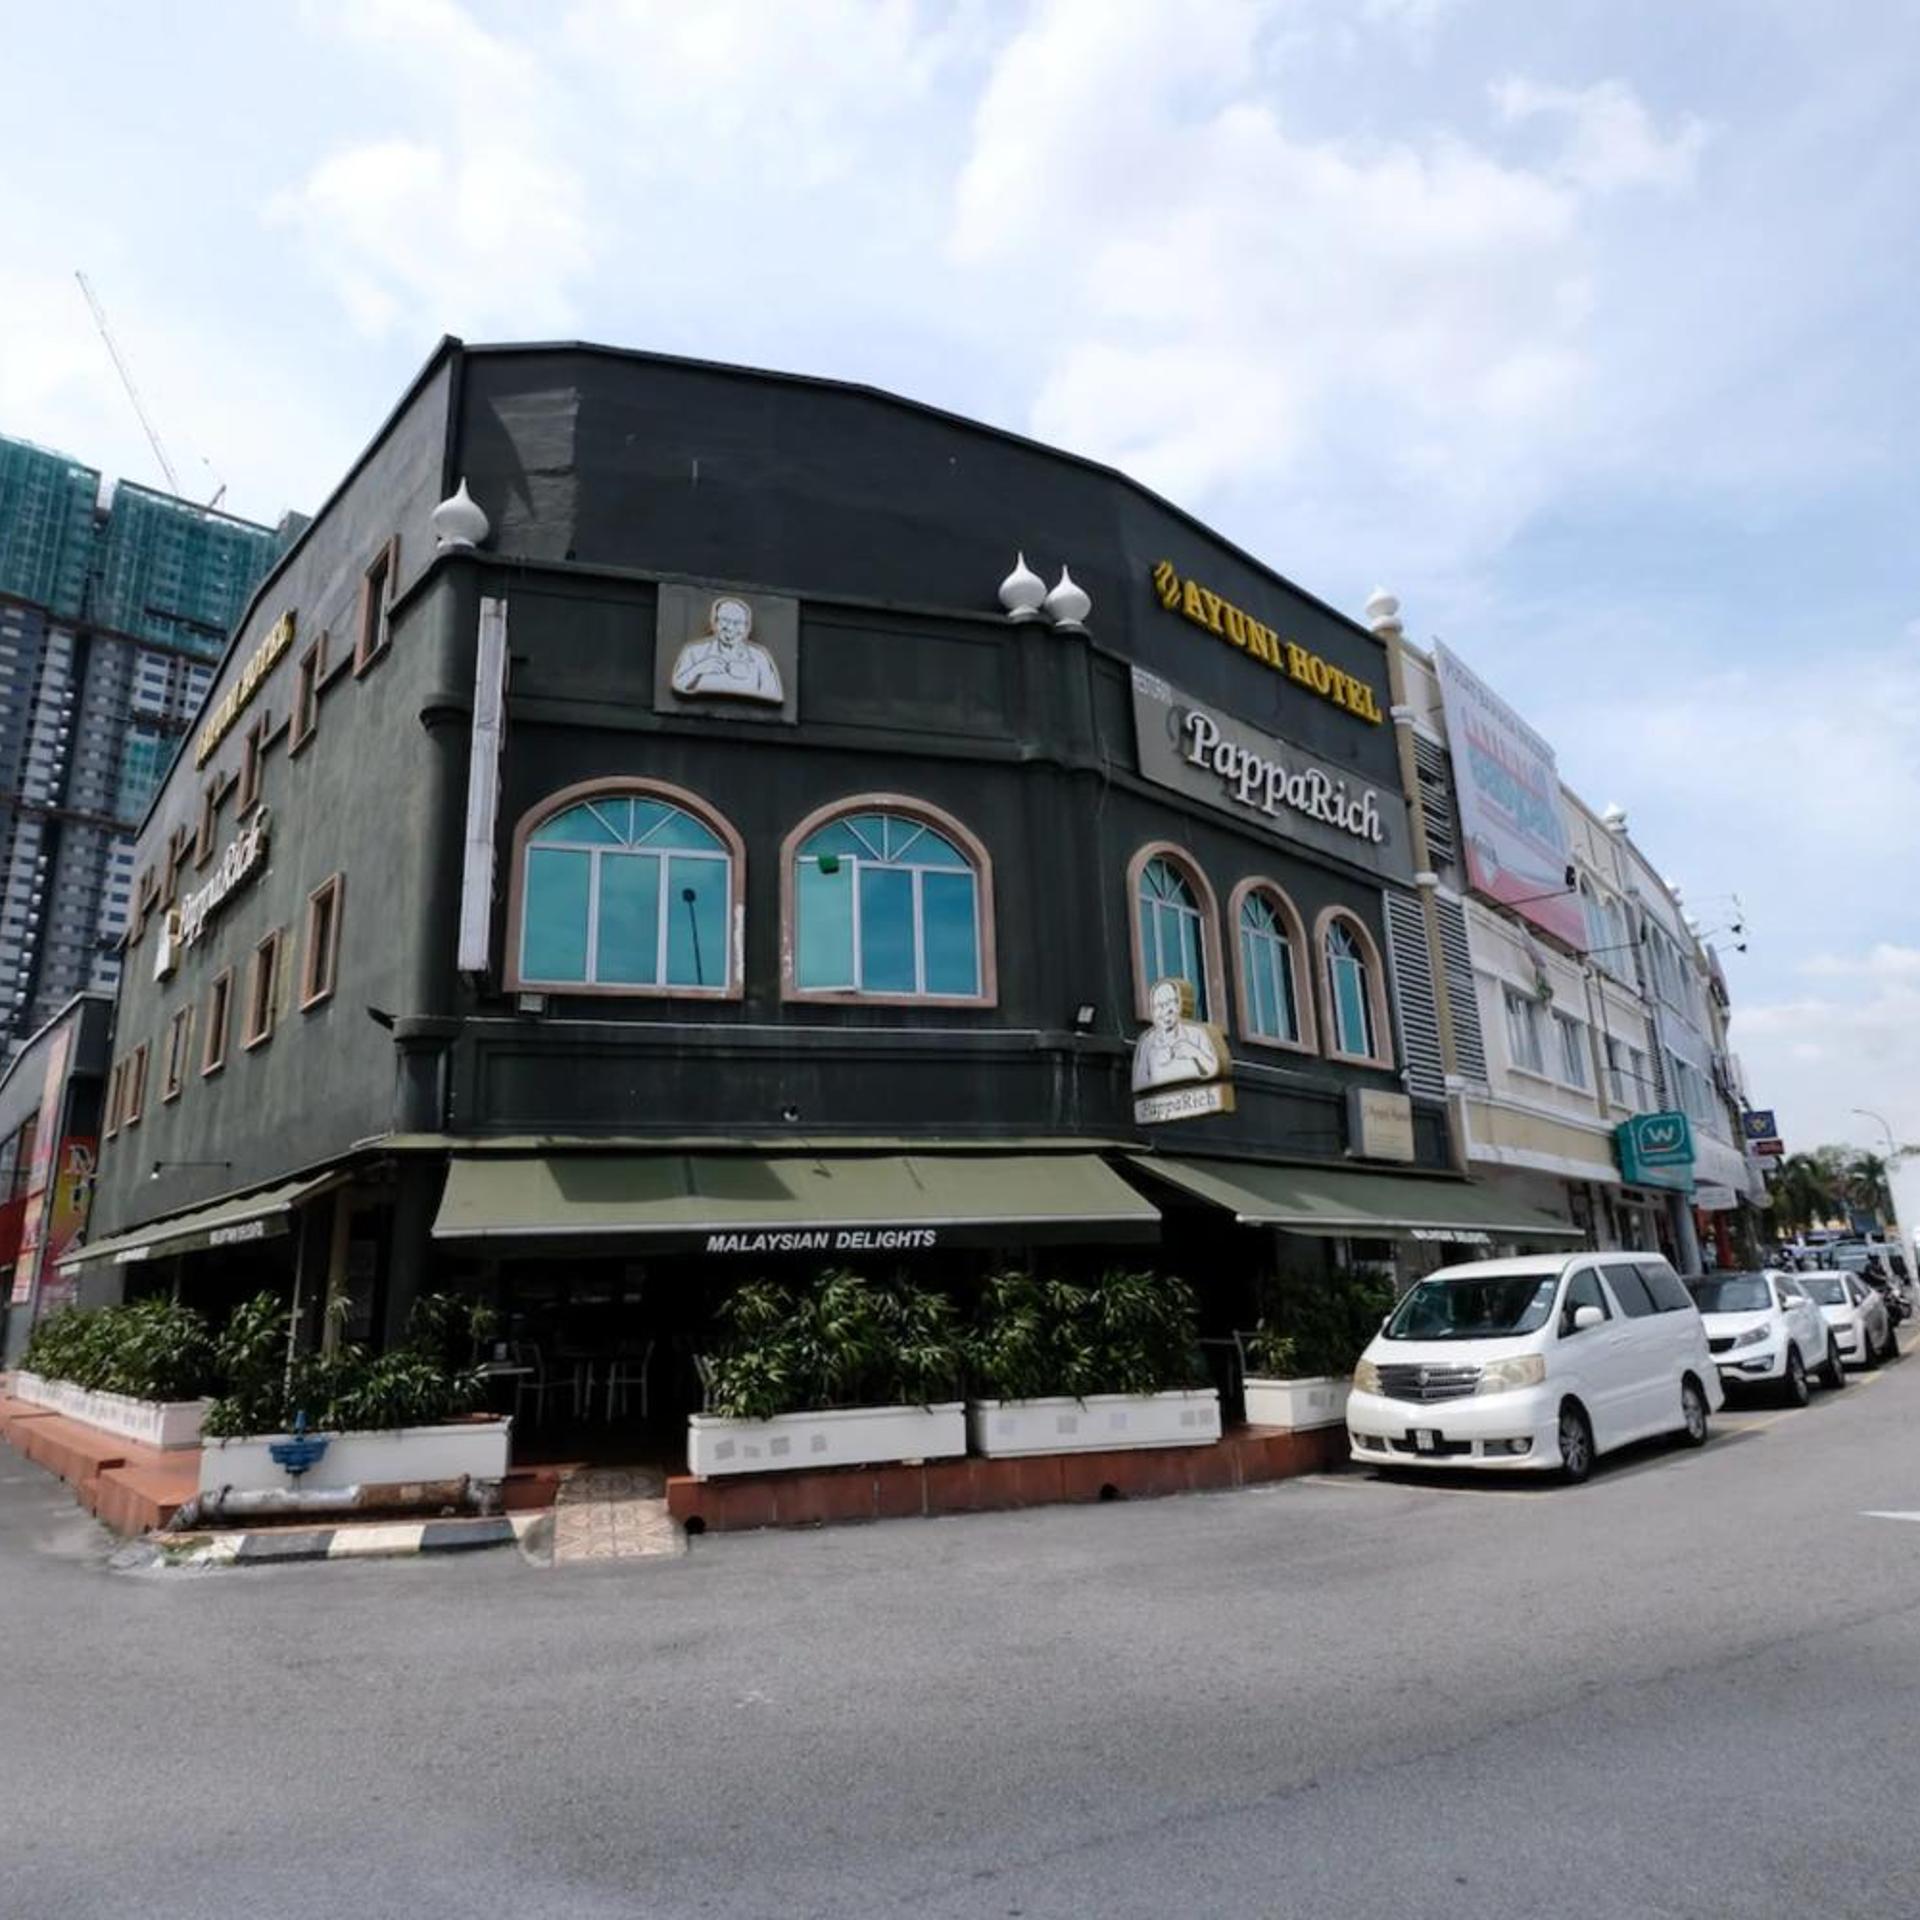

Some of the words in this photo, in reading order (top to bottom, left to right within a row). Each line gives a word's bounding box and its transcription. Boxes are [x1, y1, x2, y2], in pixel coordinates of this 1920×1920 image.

[1182, 580, 1284, 670] AYUNI
[1287, 641, 1383, 726] HOTEL
[1183, 711, 1383, 843] PappaRich
[1141, 1089, 1217, 1119] PappaRich
[706, 1231, 829, 1253] MALAYSIAN
[835, 1229, 937, 1249] DELIGHTS
